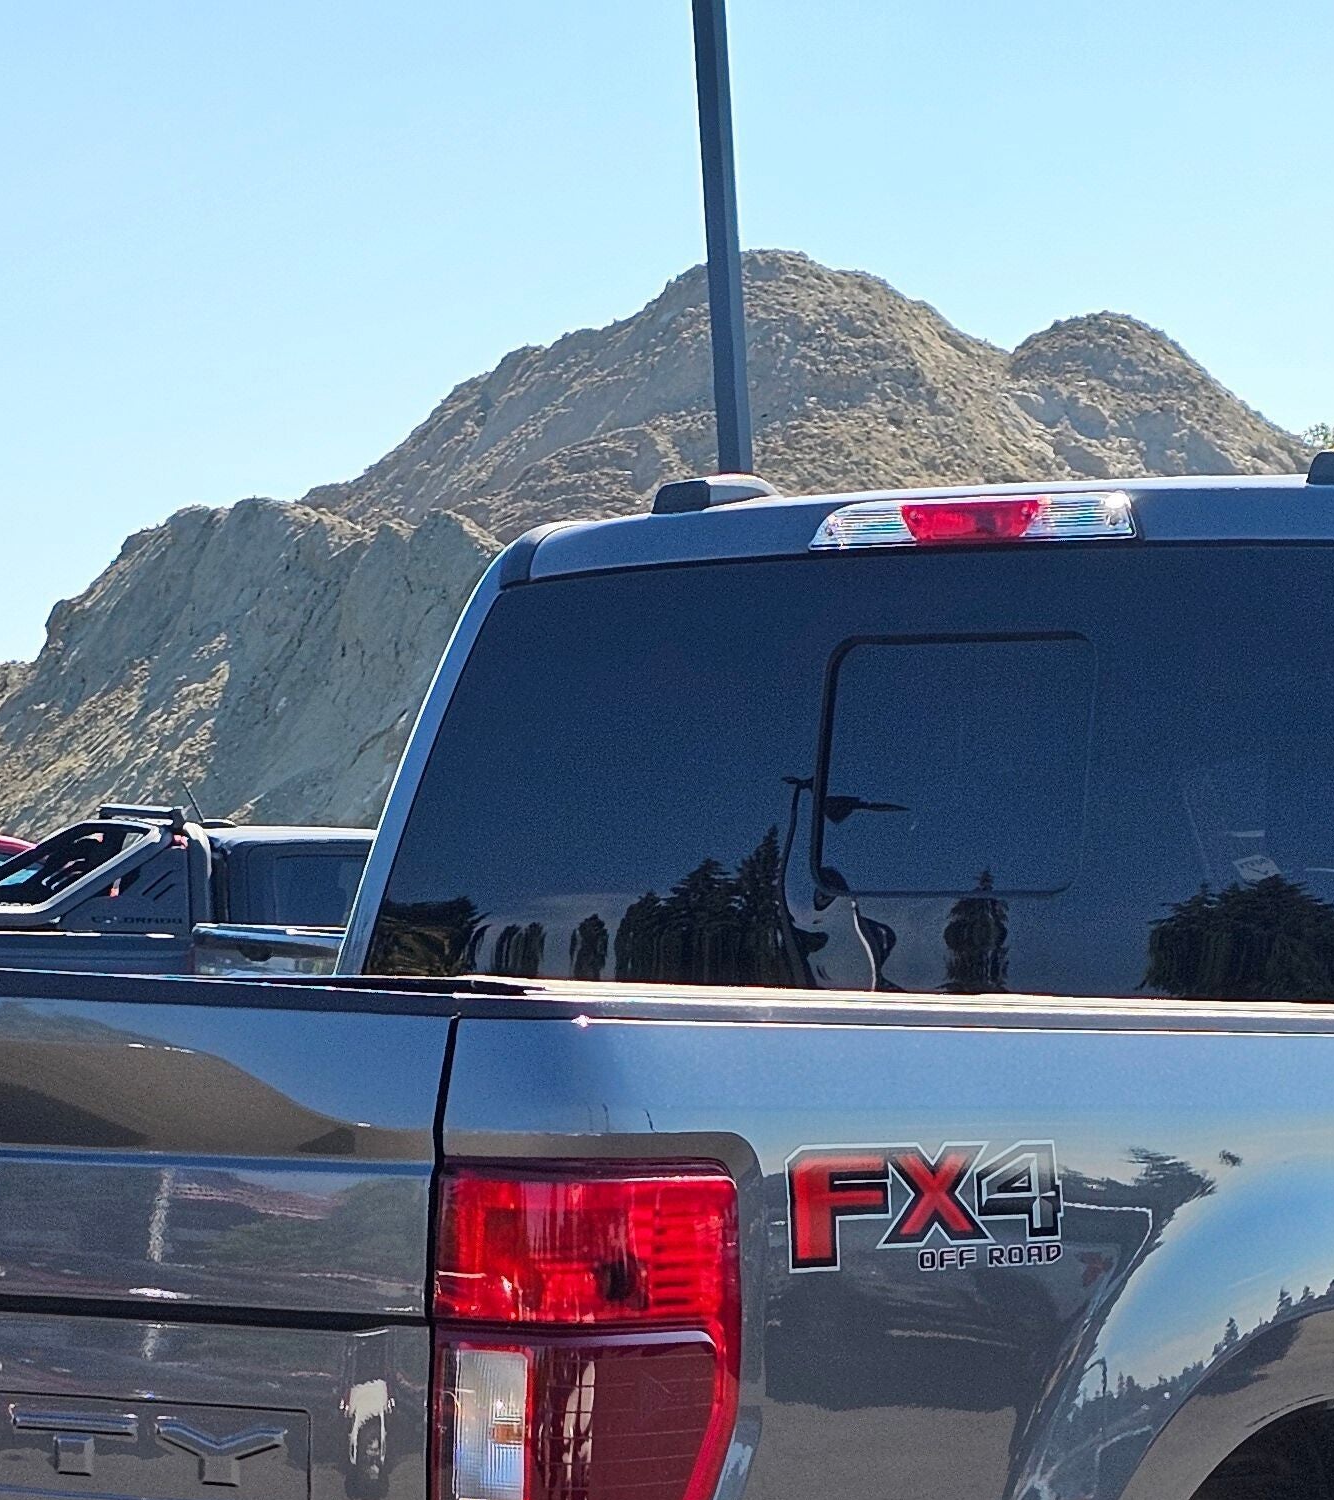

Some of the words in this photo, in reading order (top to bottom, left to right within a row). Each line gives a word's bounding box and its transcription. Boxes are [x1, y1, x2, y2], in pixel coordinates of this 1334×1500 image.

[785, 1140, 1064, 1273] FX4
[919, 1249, 977, 1271] OFF
[987, 1244, 1063, 1268] ROAD
